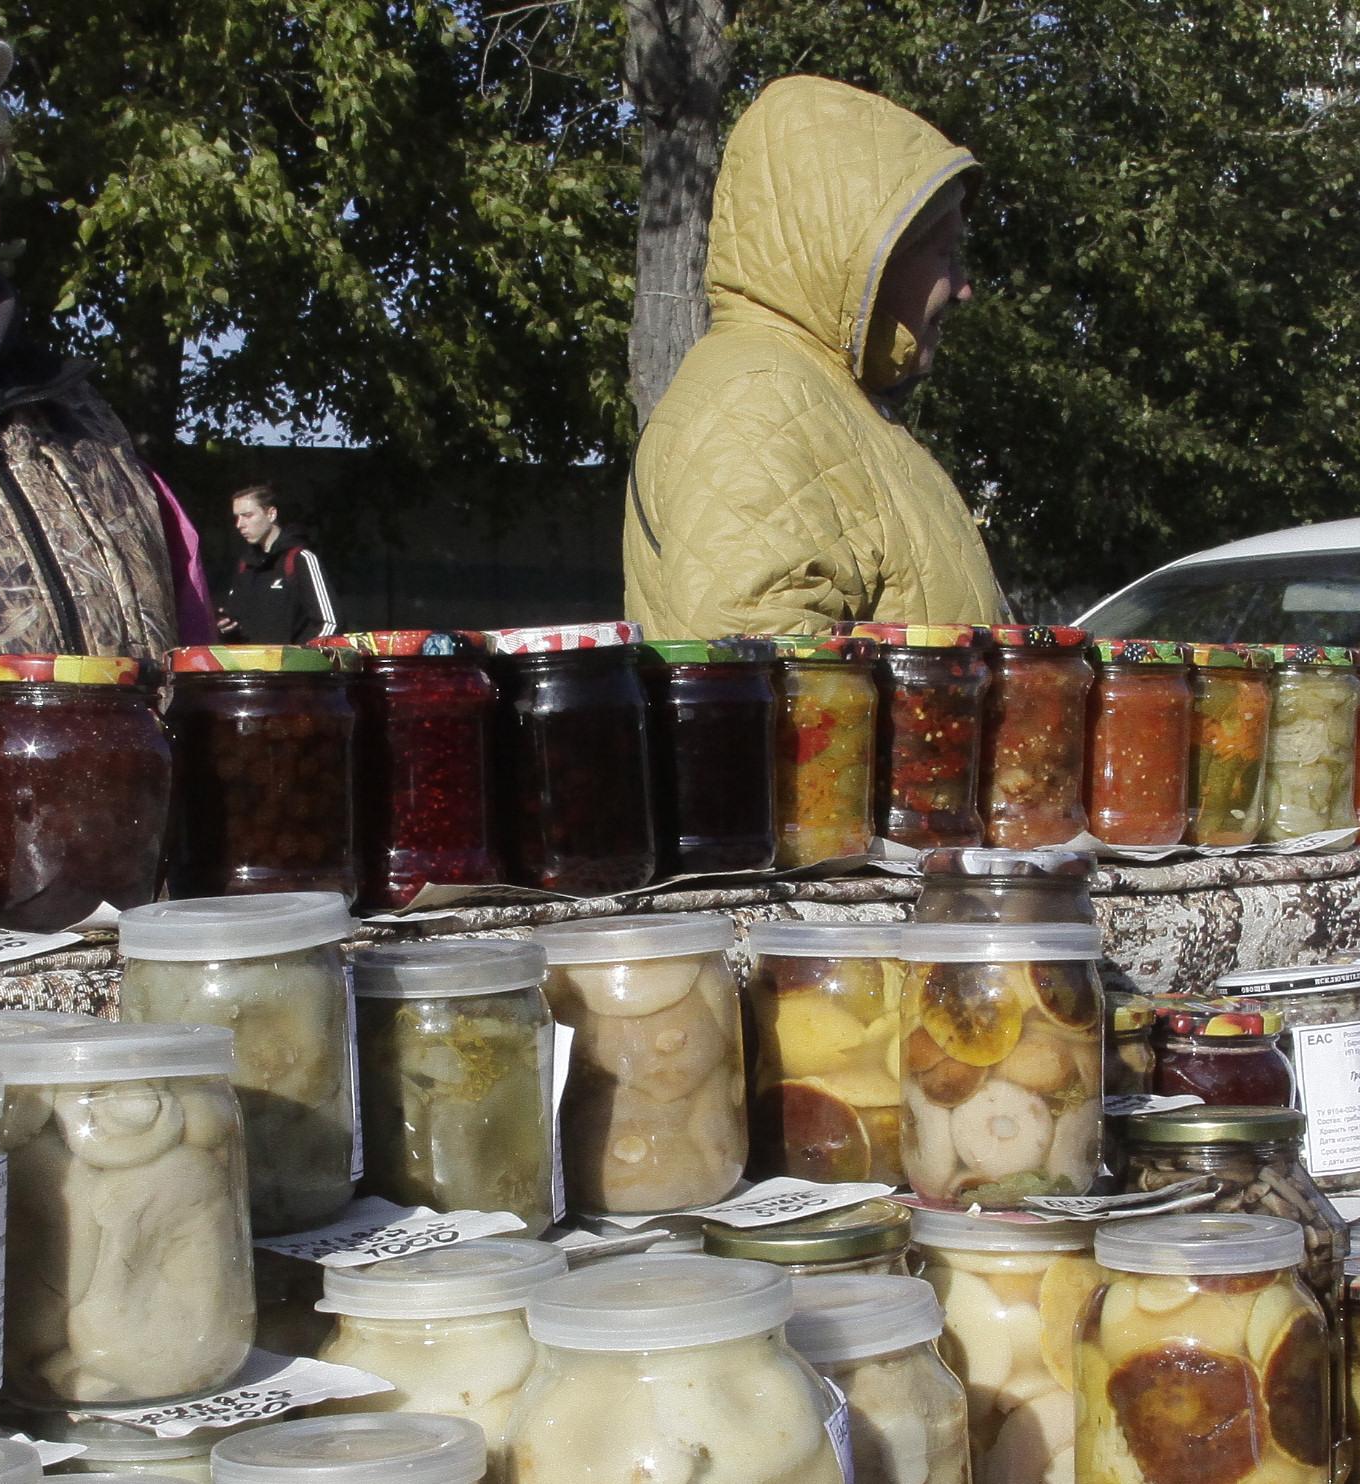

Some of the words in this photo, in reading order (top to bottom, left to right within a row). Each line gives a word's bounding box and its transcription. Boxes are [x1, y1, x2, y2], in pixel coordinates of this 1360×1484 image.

[1307, 1033, 1333, 1045] EAC
[755, 1198, 828, 1218] 500
[364, 1230, 460, 1258] 1000
